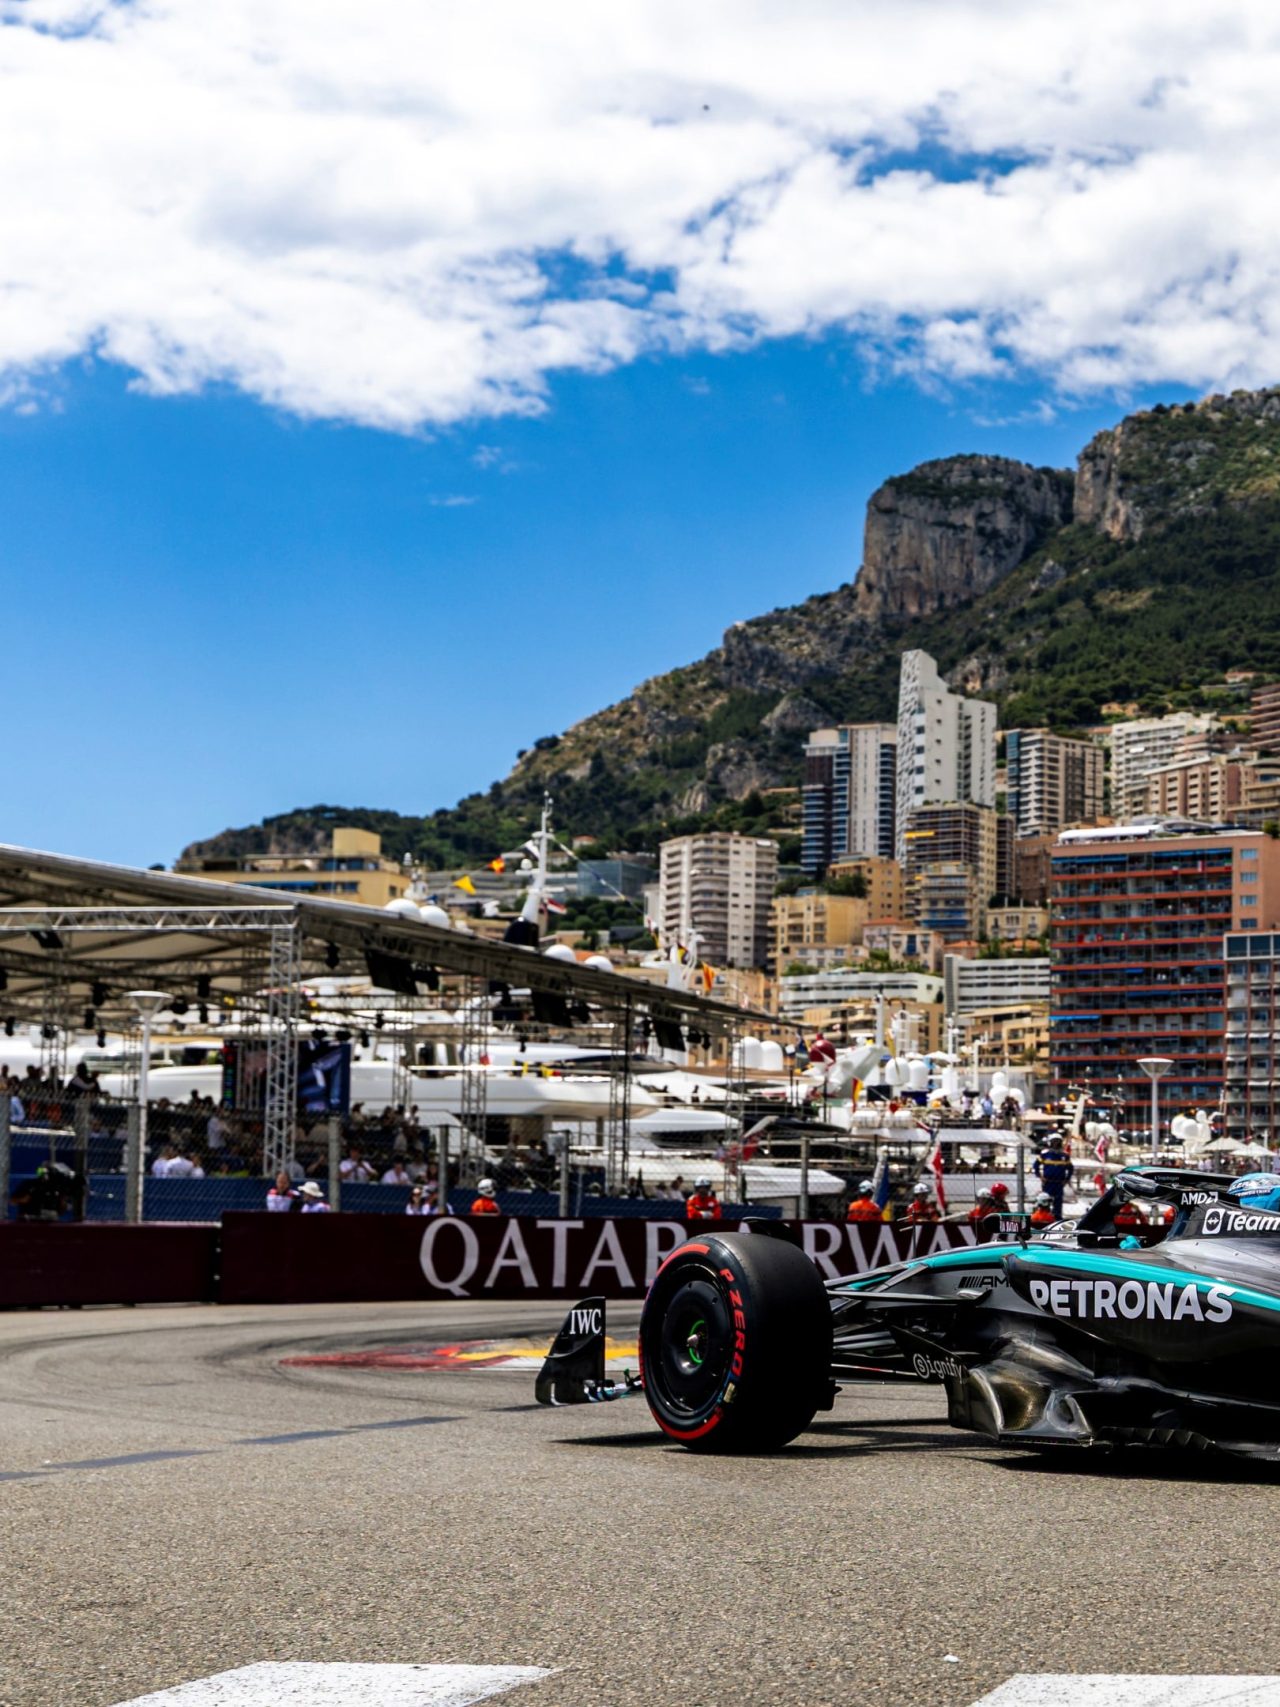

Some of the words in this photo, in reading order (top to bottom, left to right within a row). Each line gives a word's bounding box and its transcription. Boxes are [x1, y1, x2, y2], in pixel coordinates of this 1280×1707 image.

[1181, 1192, 1210, 1206] AMD
[420, 1217, 688, 1296] QATAR
[569, 1308, 602, 1334] IWC
[1029, 1280, 1237, 1323] PETRONAS
[728, 1288, 745, 1376] ZERO
